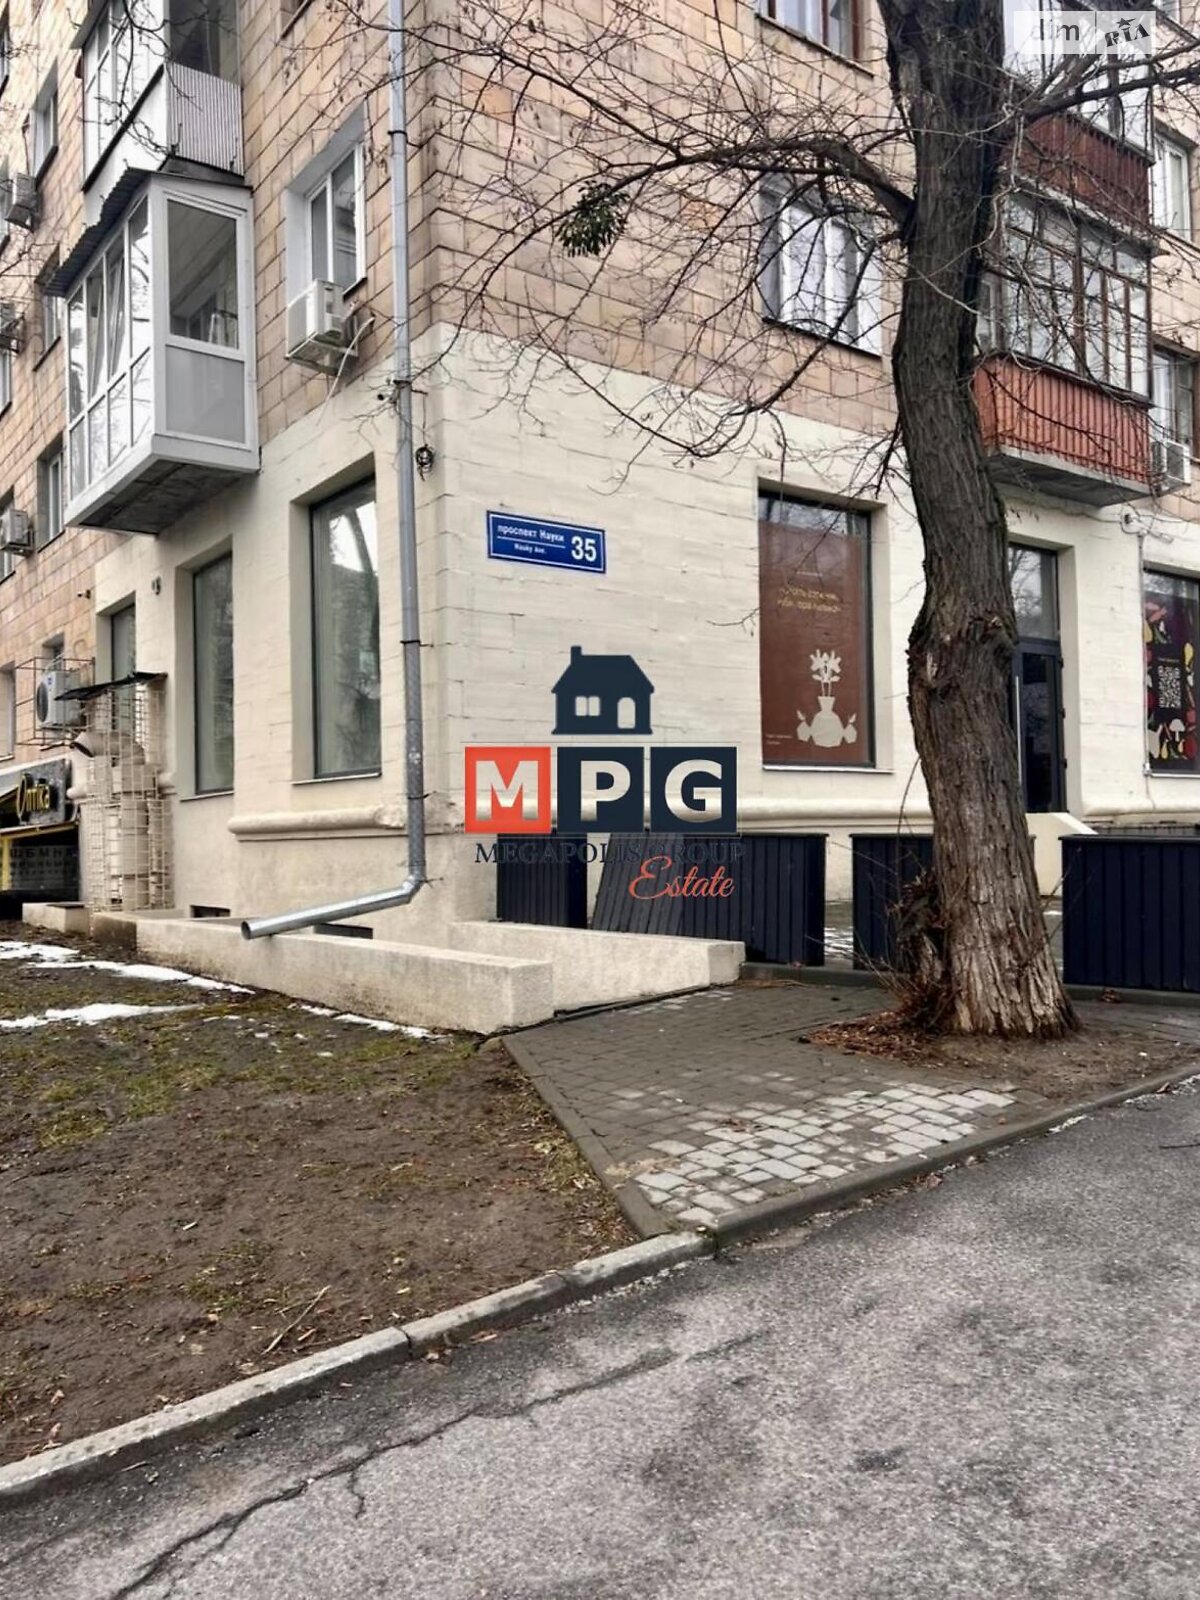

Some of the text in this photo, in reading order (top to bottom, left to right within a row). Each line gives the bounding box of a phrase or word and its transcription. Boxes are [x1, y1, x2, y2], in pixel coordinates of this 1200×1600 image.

[497, 525, 564, 543] проспект Науки
[571, 536, 597, 562] 35
